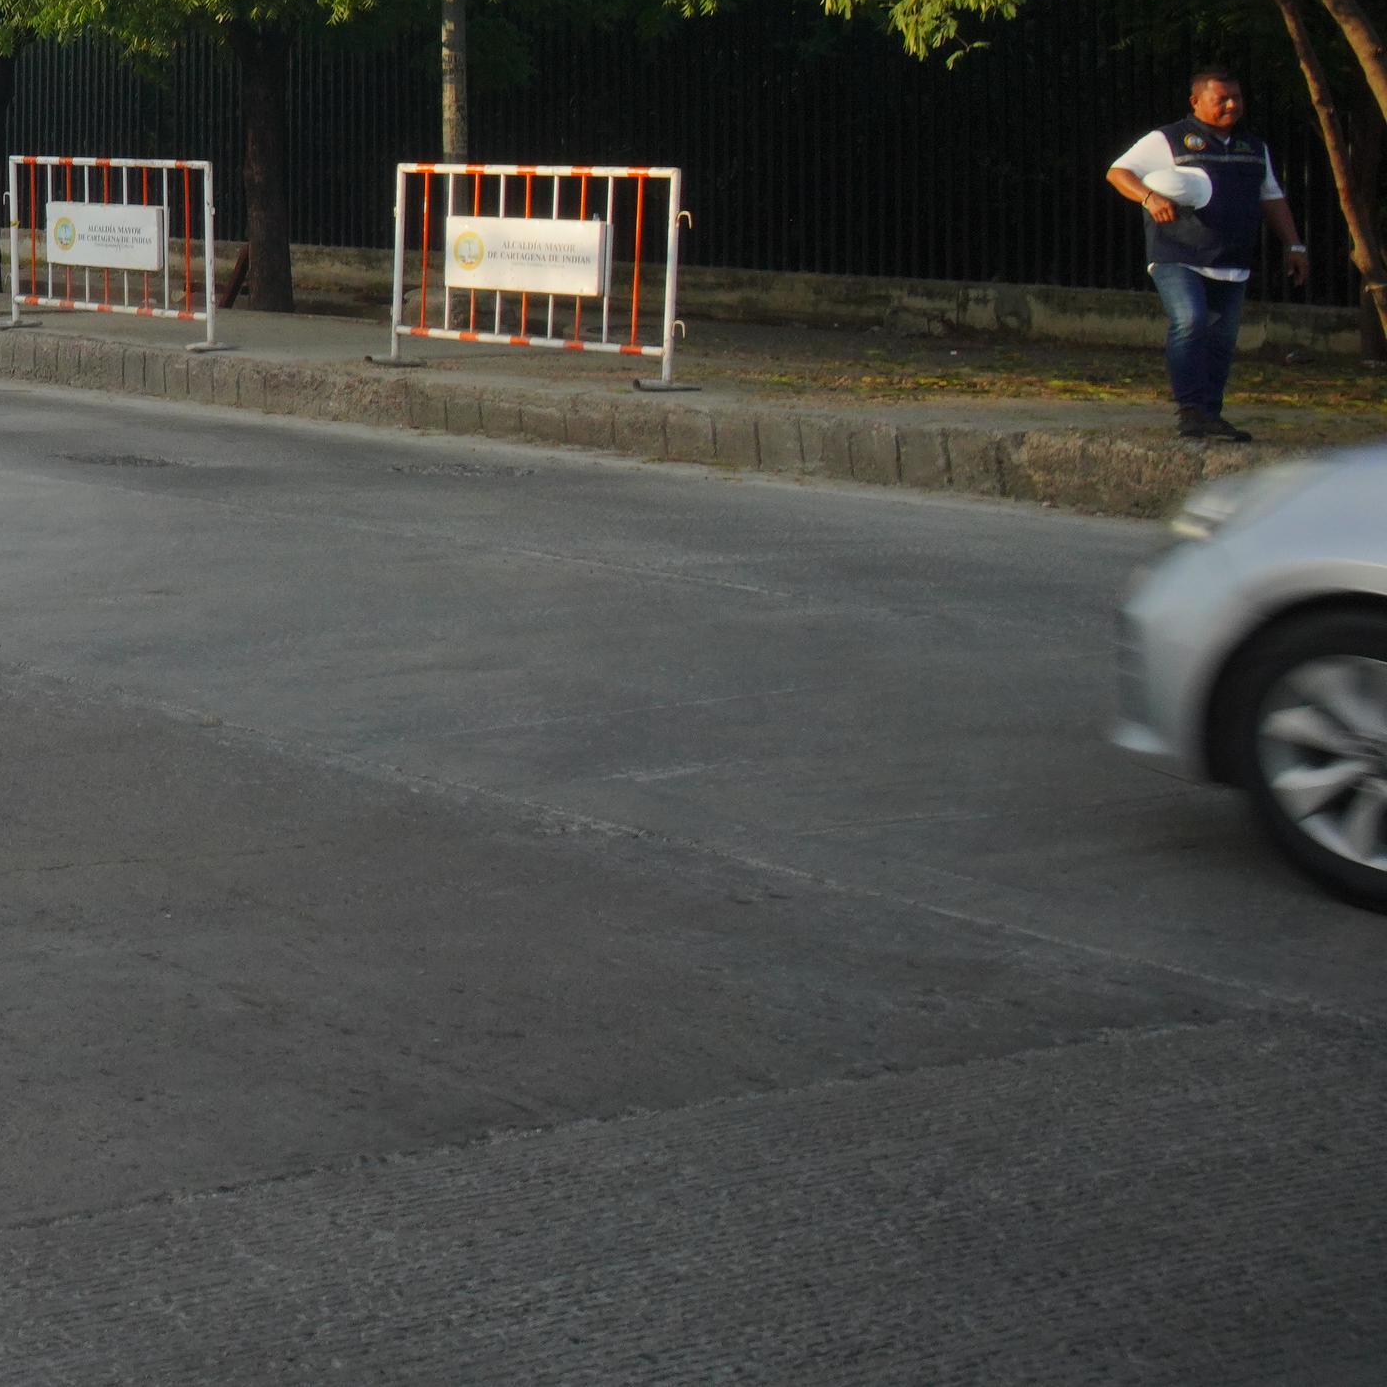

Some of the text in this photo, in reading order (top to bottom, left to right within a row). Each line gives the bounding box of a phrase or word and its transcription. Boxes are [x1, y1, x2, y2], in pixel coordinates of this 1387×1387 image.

[545, 242, 576, 253] MAYOR
[487, 251, 497, 259] DE
[500, 251, 546, 262] CARTAGENA
[548, 254, 559, 262] DE
[562, 254, 591, 265] INDIAS
